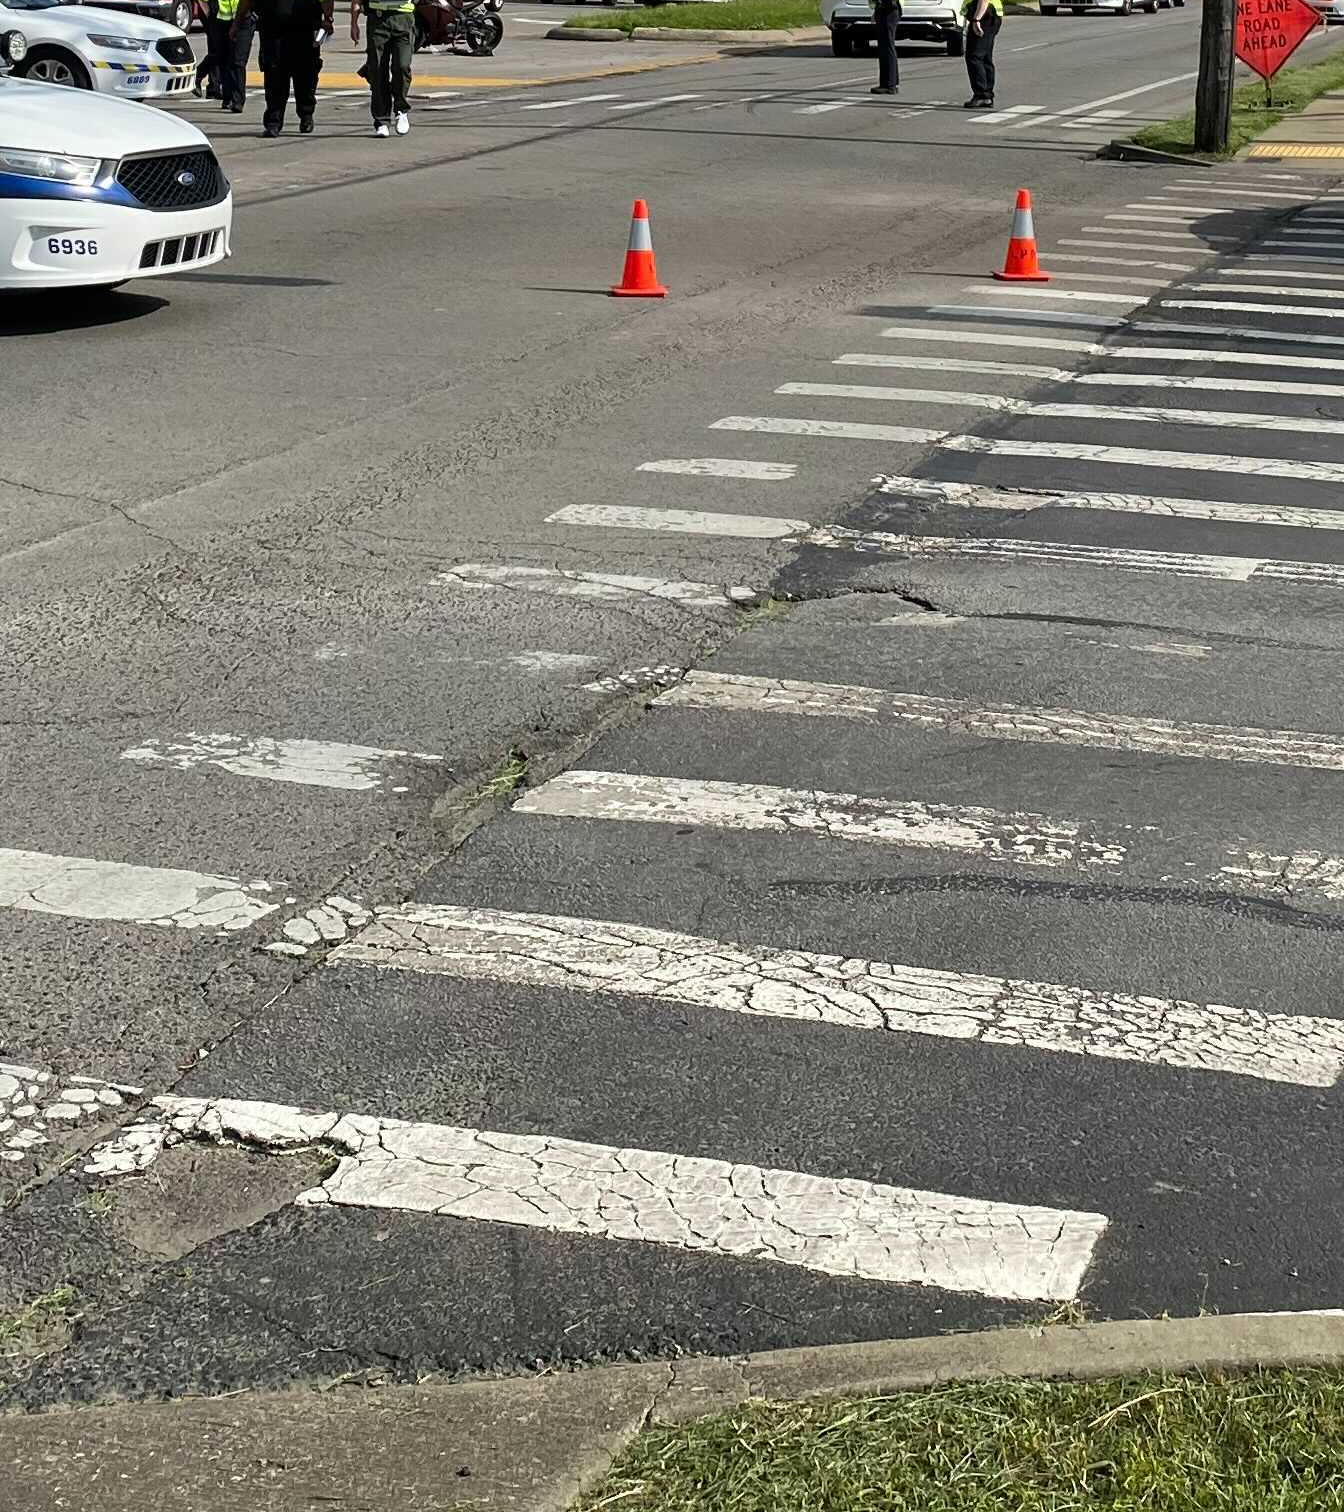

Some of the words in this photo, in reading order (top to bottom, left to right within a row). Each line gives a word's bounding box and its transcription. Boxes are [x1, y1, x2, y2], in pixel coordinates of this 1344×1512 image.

[1237, 1, 1253, 17] NE
[1243, 17, 1281, 33] ROAD
[1242, 34, 1287, 52] AHEAD
[48, 238, 98, 255] 6936
